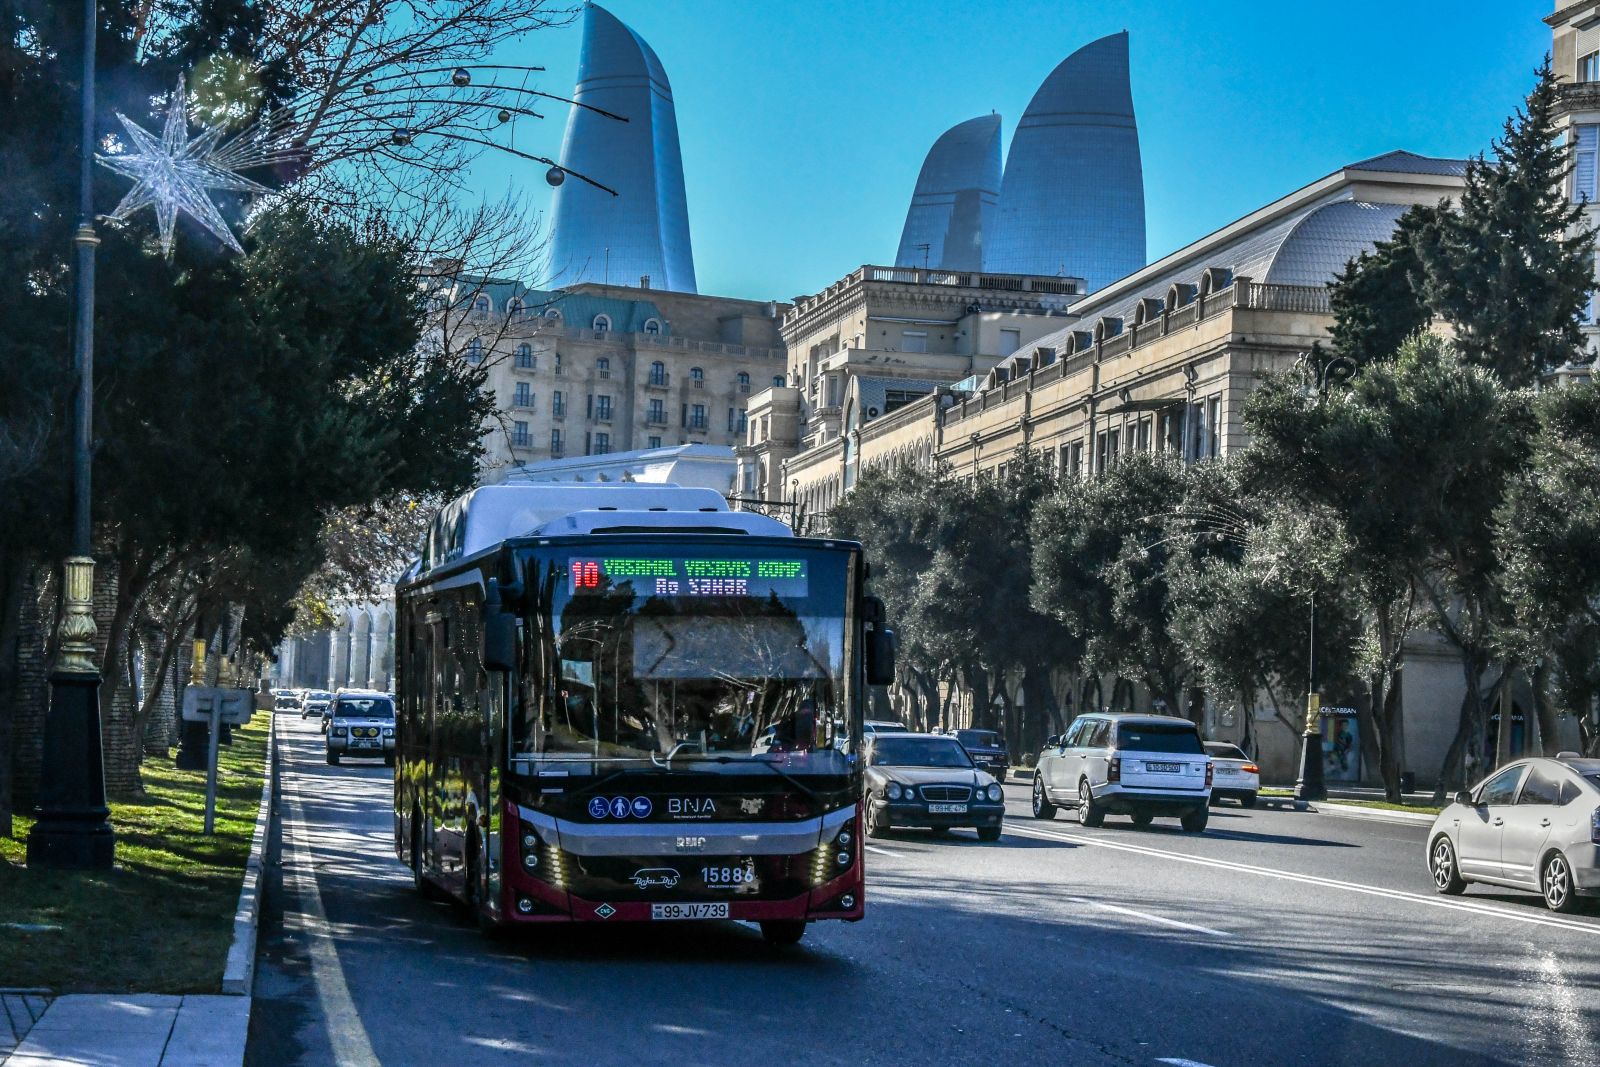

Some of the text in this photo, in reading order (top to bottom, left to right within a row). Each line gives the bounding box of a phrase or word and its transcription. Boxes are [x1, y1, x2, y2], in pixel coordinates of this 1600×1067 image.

[572, 561, 598, 587] 10
[668, 798, 716, 813] BNA
[701, 867, 753, 883] 15886
[664, 904, 726, 918] 99-JV-739
